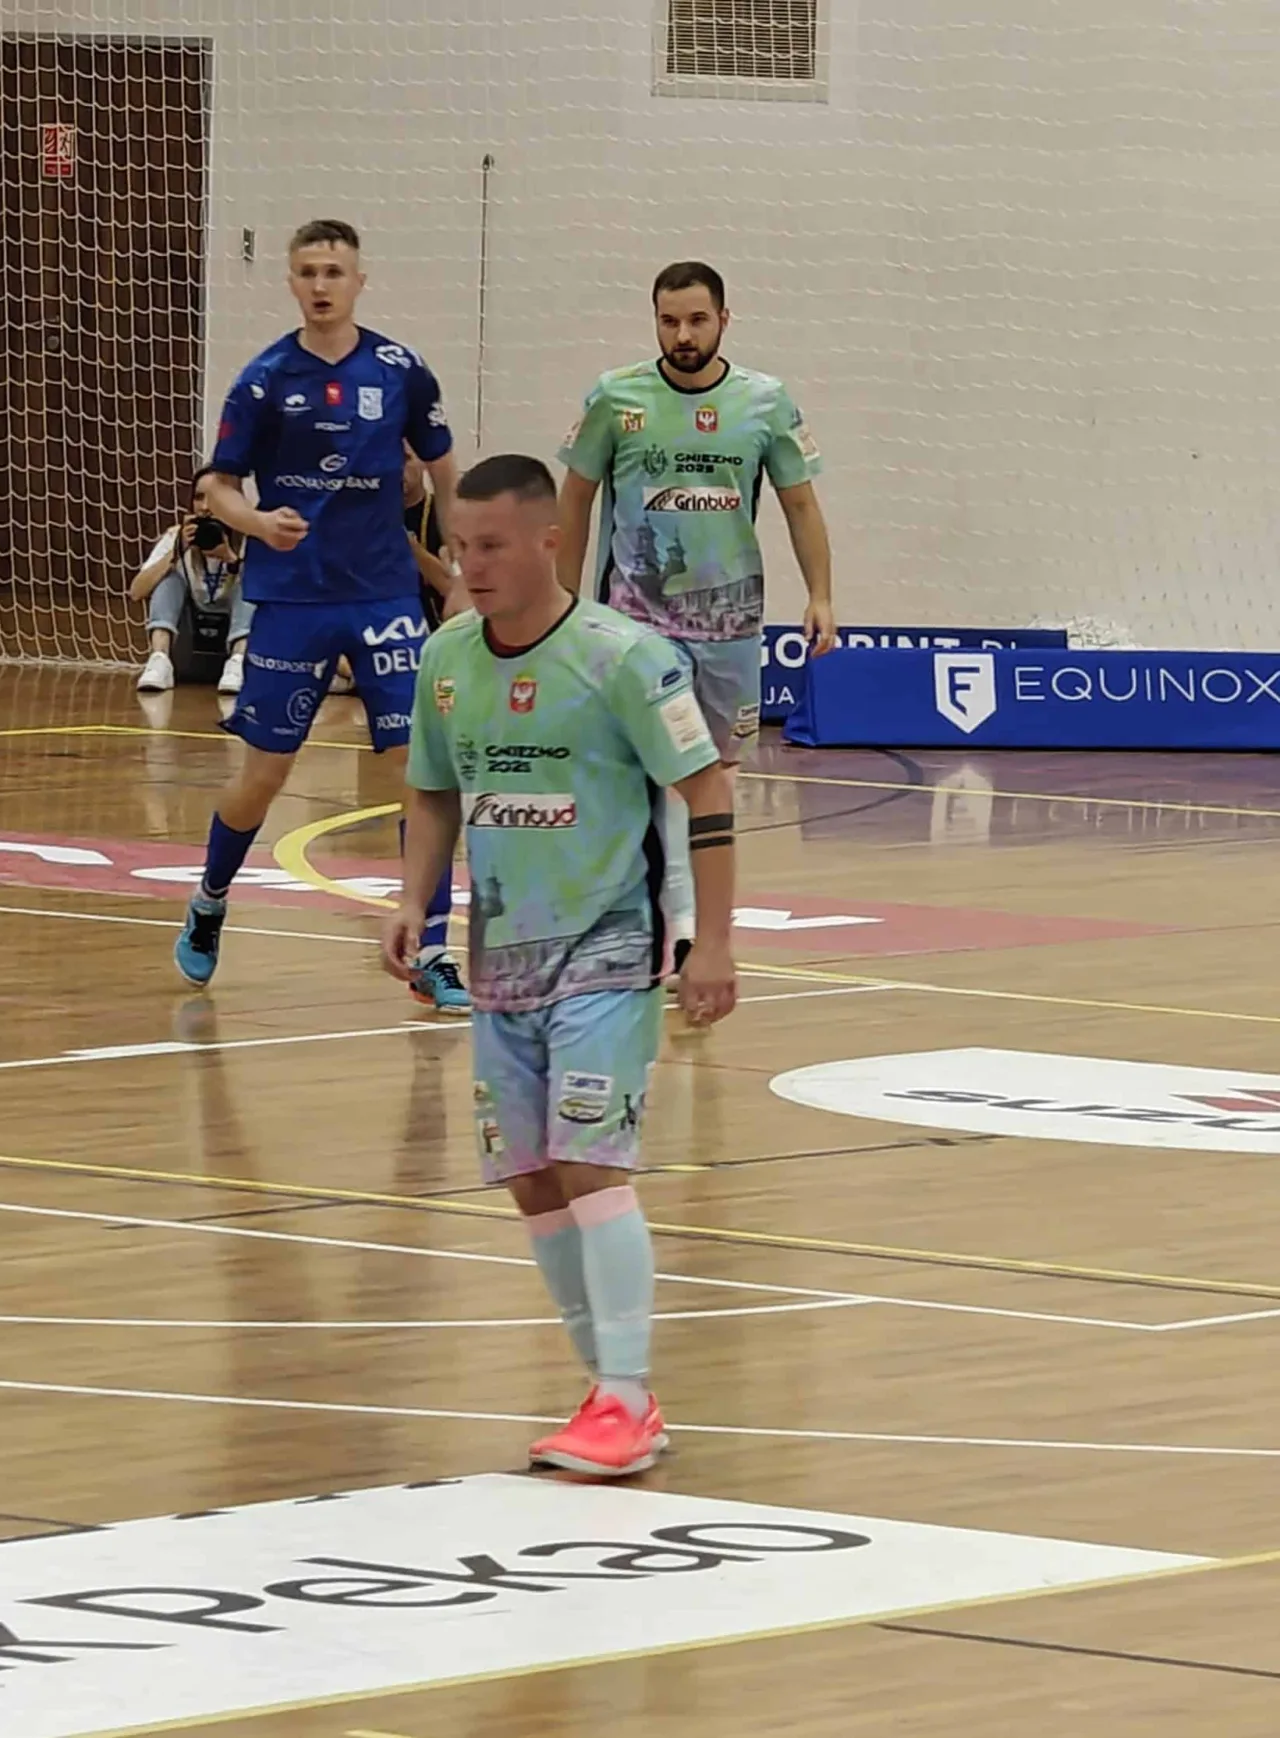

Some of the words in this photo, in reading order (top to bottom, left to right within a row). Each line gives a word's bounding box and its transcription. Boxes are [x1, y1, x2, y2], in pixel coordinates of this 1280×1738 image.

[675, 494, 742, 511] Grinbud
[1015, 667, 1280, 702] EQUINOX
[490, 803, 576, 825] Grinbud
[17, 1523, 872, 1633] Pekao
